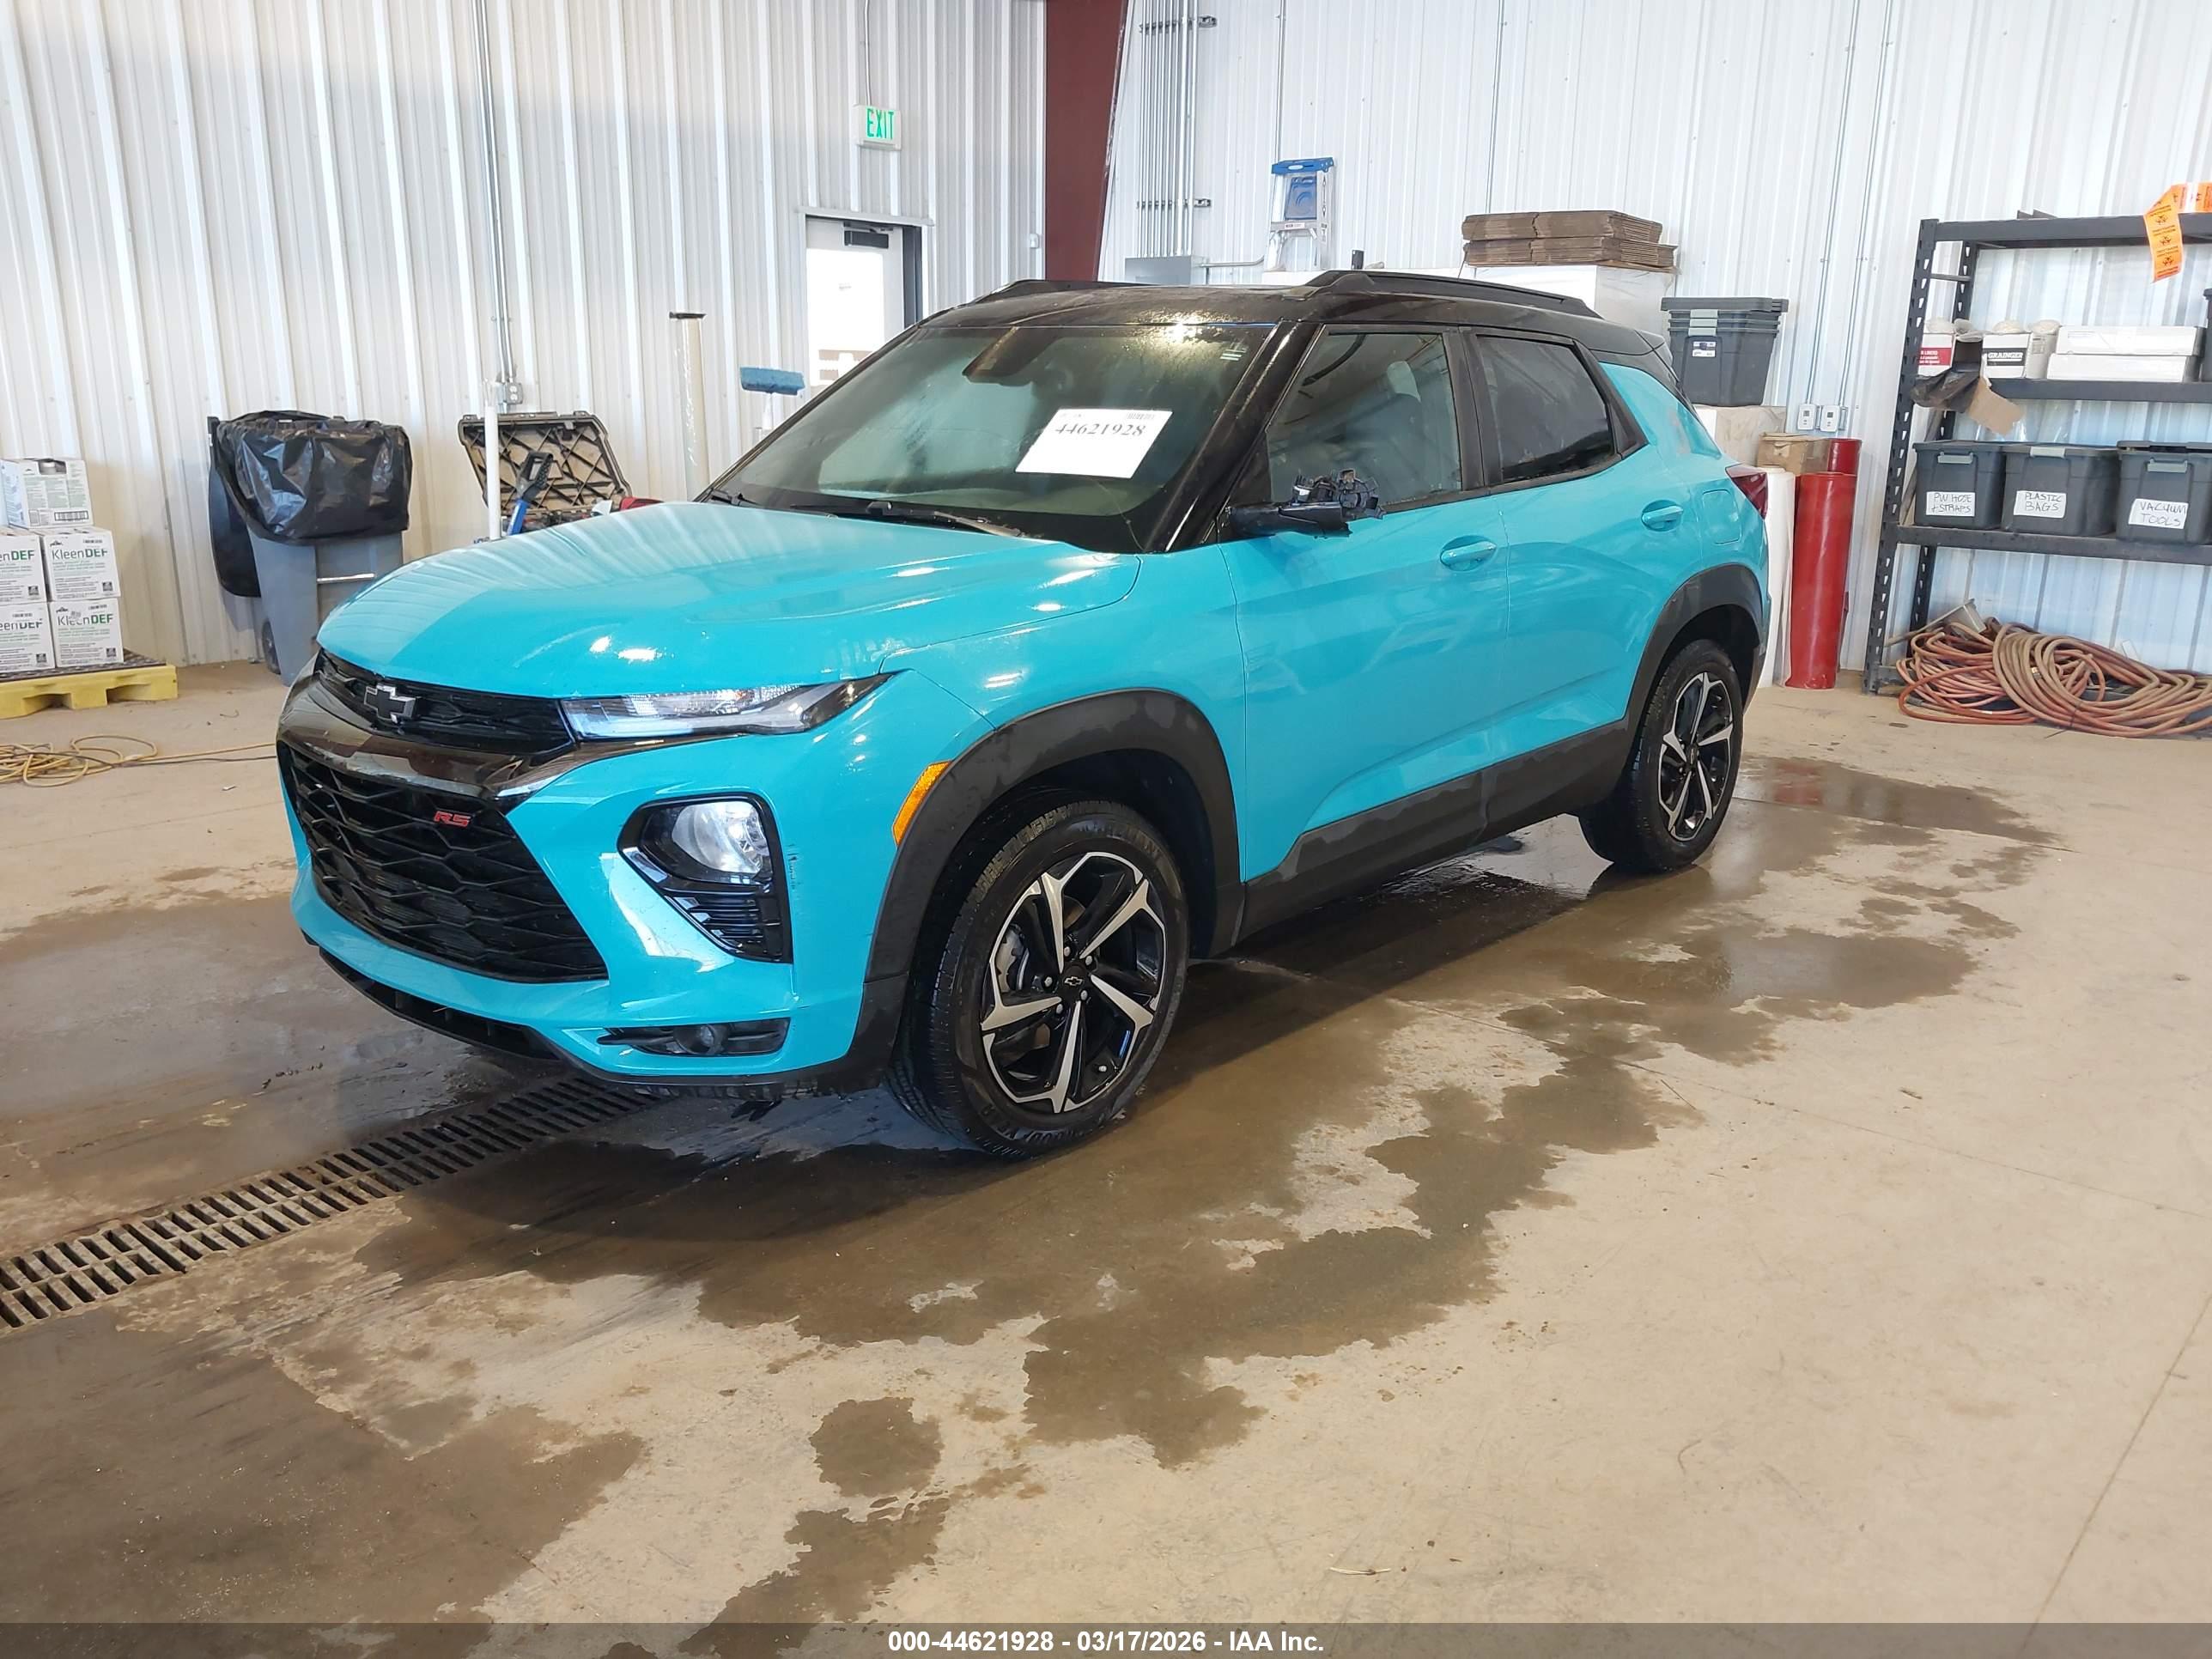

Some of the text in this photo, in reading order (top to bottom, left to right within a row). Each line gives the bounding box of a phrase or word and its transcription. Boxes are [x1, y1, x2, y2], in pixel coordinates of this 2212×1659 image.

[866, 108, 894, 140] EXIT
[1055, 423, 1146, 436] 44621928
[2025, 491, 2063, 502] PLASTIC
[2025, 501, 2059, 513] BAGS
[2140, 501, 2186, 514] VACUUM
[2140, 513, 2182, 527] TOOLS
[52, 548, 108, 561] KleenDEF
[57, 613, 113, 626] KleenDEF
[434, 811, 471, 827] RS
